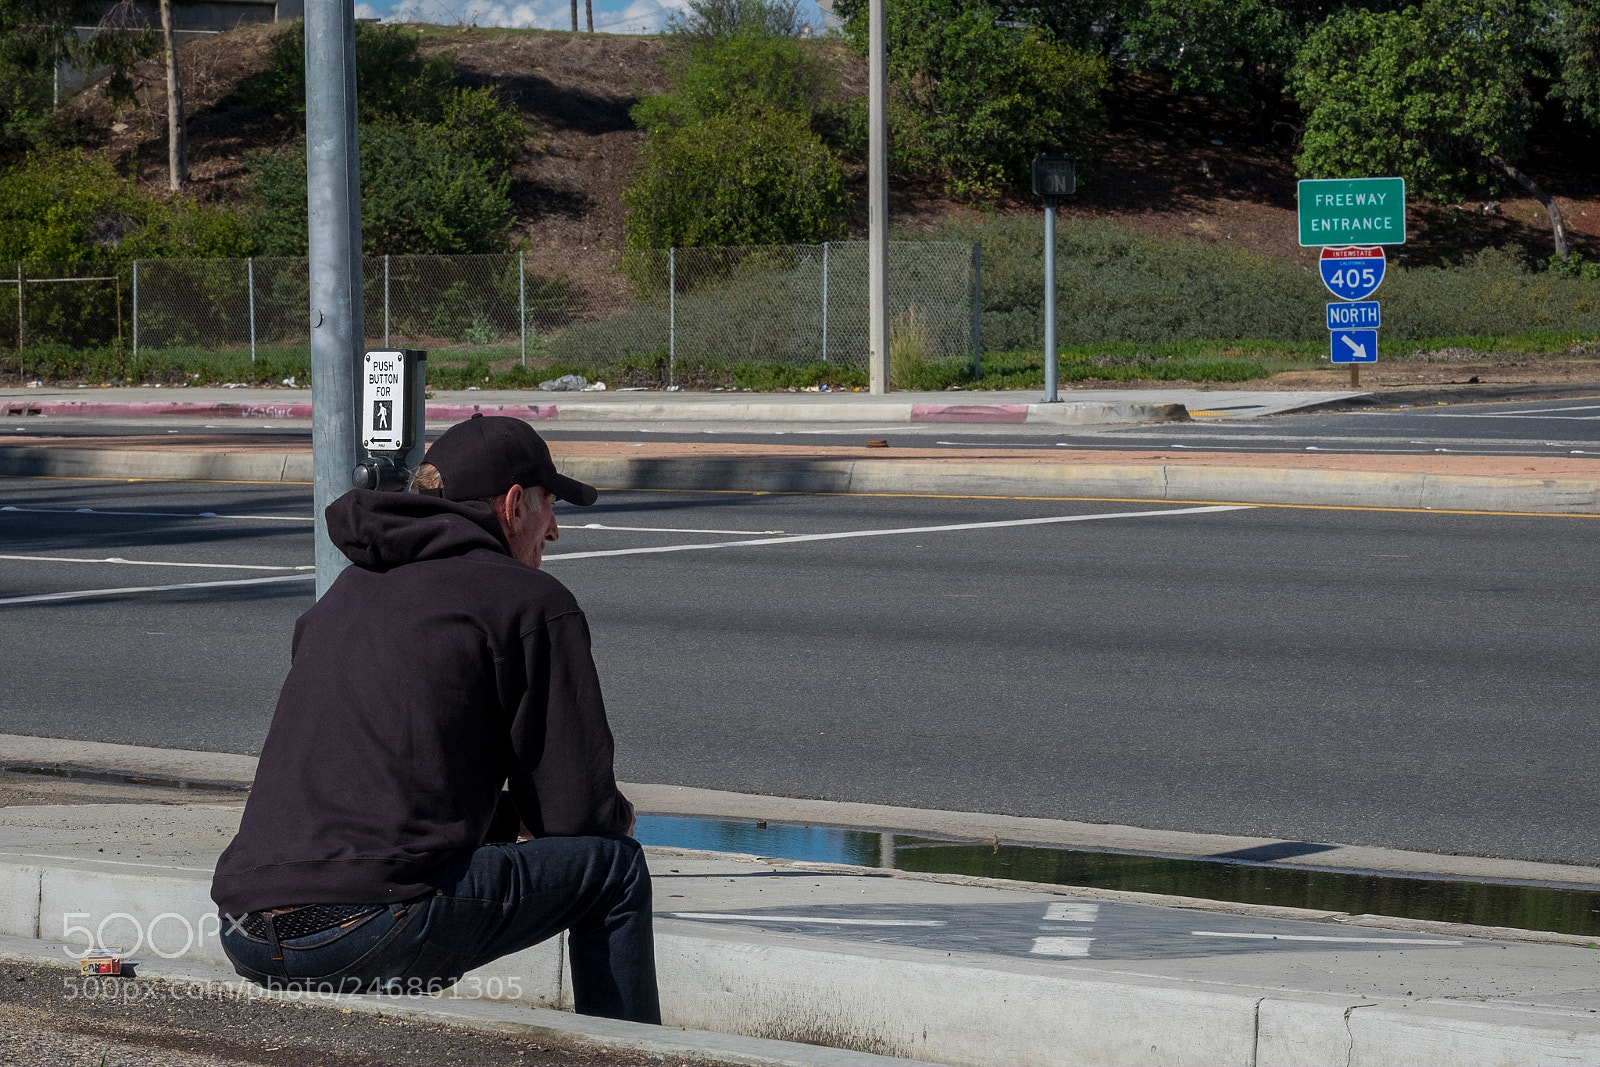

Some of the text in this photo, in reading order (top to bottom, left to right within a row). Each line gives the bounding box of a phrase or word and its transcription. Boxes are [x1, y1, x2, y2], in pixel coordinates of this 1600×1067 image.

[1315, 193, 1387, 206] FREEWAY
[1311, 217, 1392, 231] ENTRANCE
[1330, 268, 1375, 288] 405
[1330, 307, 1377, 323] NORTH
[373, 361, 394, 372] PUSH
[369, 373, 399, 384] BUTTON
[376, 386, 391, 397] FOR
